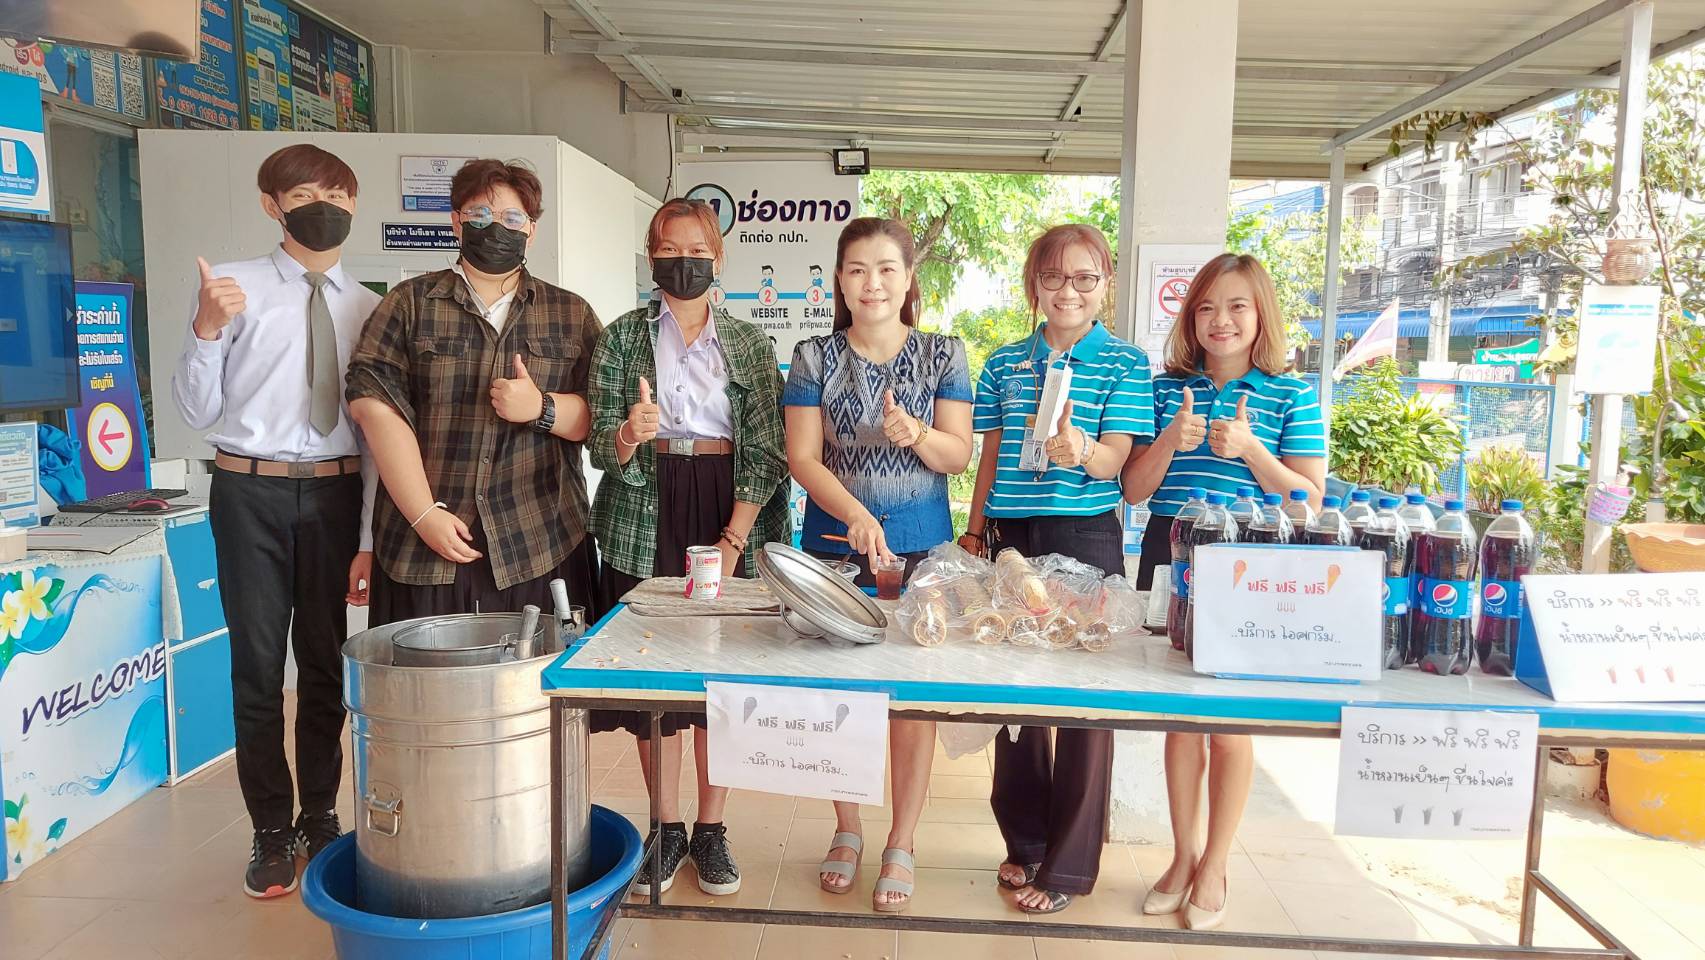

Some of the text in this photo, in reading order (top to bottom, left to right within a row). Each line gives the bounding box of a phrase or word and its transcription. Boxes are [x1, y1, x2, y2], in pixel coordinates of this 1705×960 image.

[738, 189, 851, 222] ช่องทาง
[386, 227, 407, 236] บริษัท
[739, 230, 809, 243] ติดต่อ กปภ.
[713, 291, 719, 303] 1
[764, 289, 771, 302] 2
[812, 289, 819, 302] 3
[751, 308, 788, 318] WEBSITE
[804, 308, 833, 318] E-MAIL
[800, 321, 833, 332] pr@pwa.co.
[1247, 579, 1326, 595] ฟรี ฟรี ฟรี
[1547, 590, 1595, 608] บริการ
[1617, 589, 1643, 607] ฟรี
[1647, 589, 1672, 607] ฟรี
[1676, 588, 1701, 607] ฟรี
[22, 645, 166, 735] WELCOME
[757, 716, 834, 733] ฟรี ฟรี ฟรี
[1357, 723, 1406, 745] บริการ
[1432, 727, 1458, 748] ฟรี
[1464, 728, 1489, 749] ฟรี
[1495, 729, 1521, 750] ฟรี
